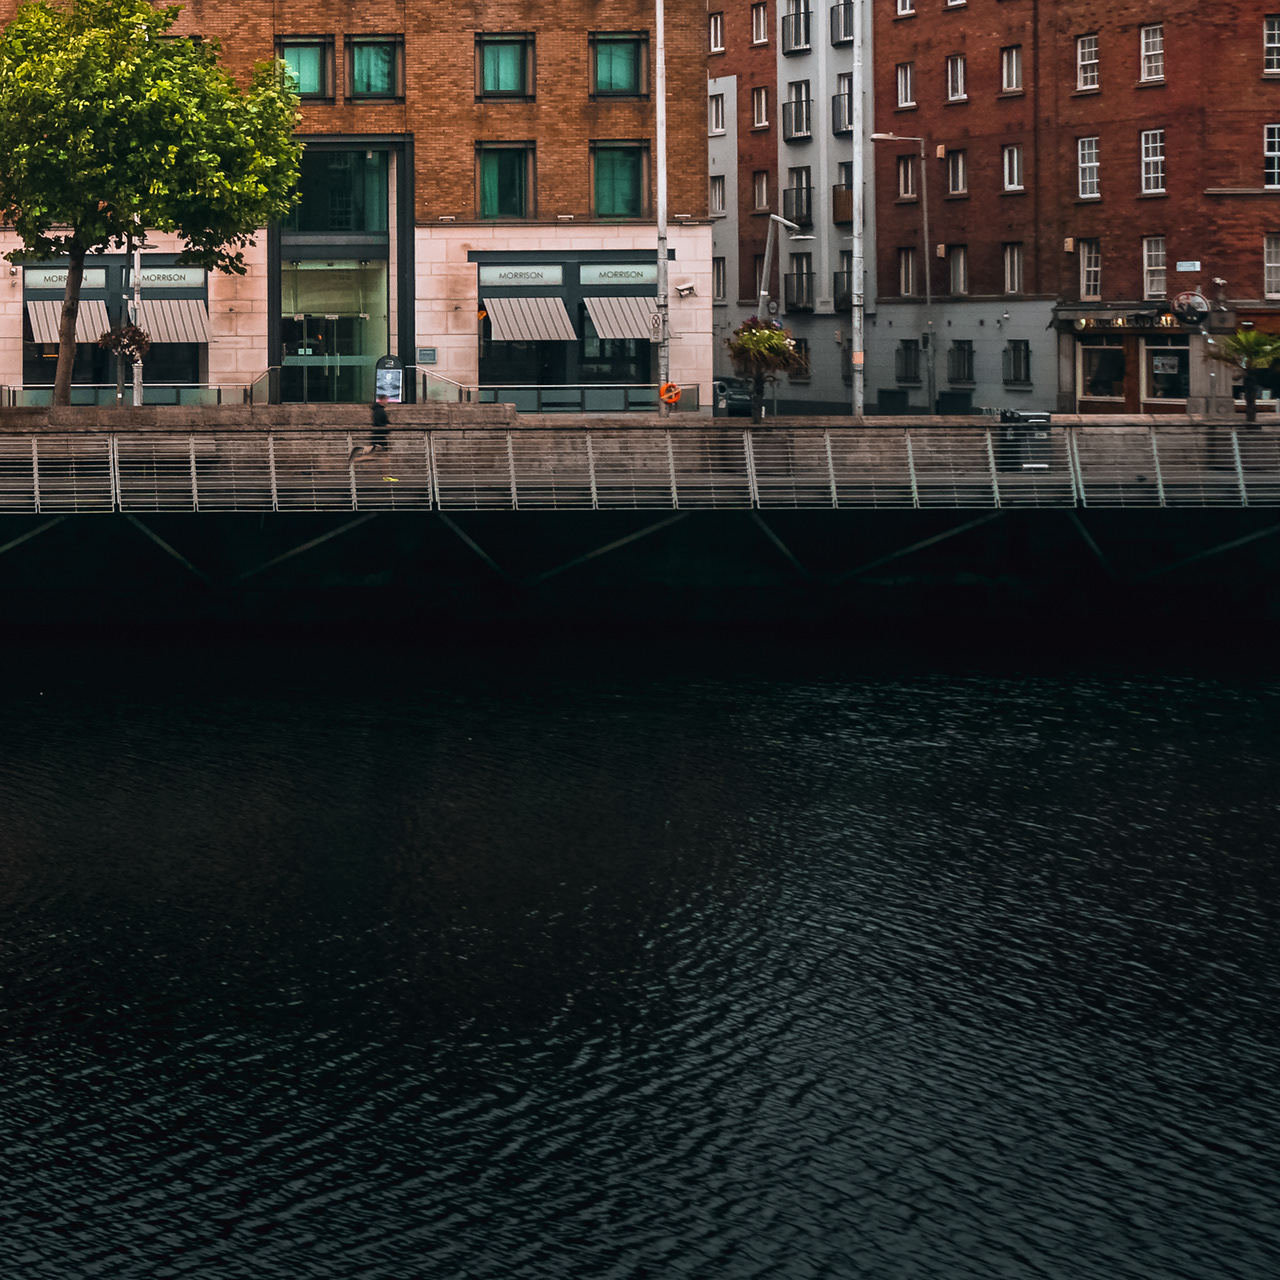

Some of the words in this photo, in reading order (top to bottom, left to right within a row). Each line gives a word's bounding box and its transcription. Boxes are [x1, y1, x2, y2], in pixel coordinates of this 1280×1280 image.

[43, 275, 88, 283] MORRN
[142, 274, 186, 282] MORRISON
[498, 272, 544, 280] MORRISON
[598, 271, 644, 279] MORRISON
